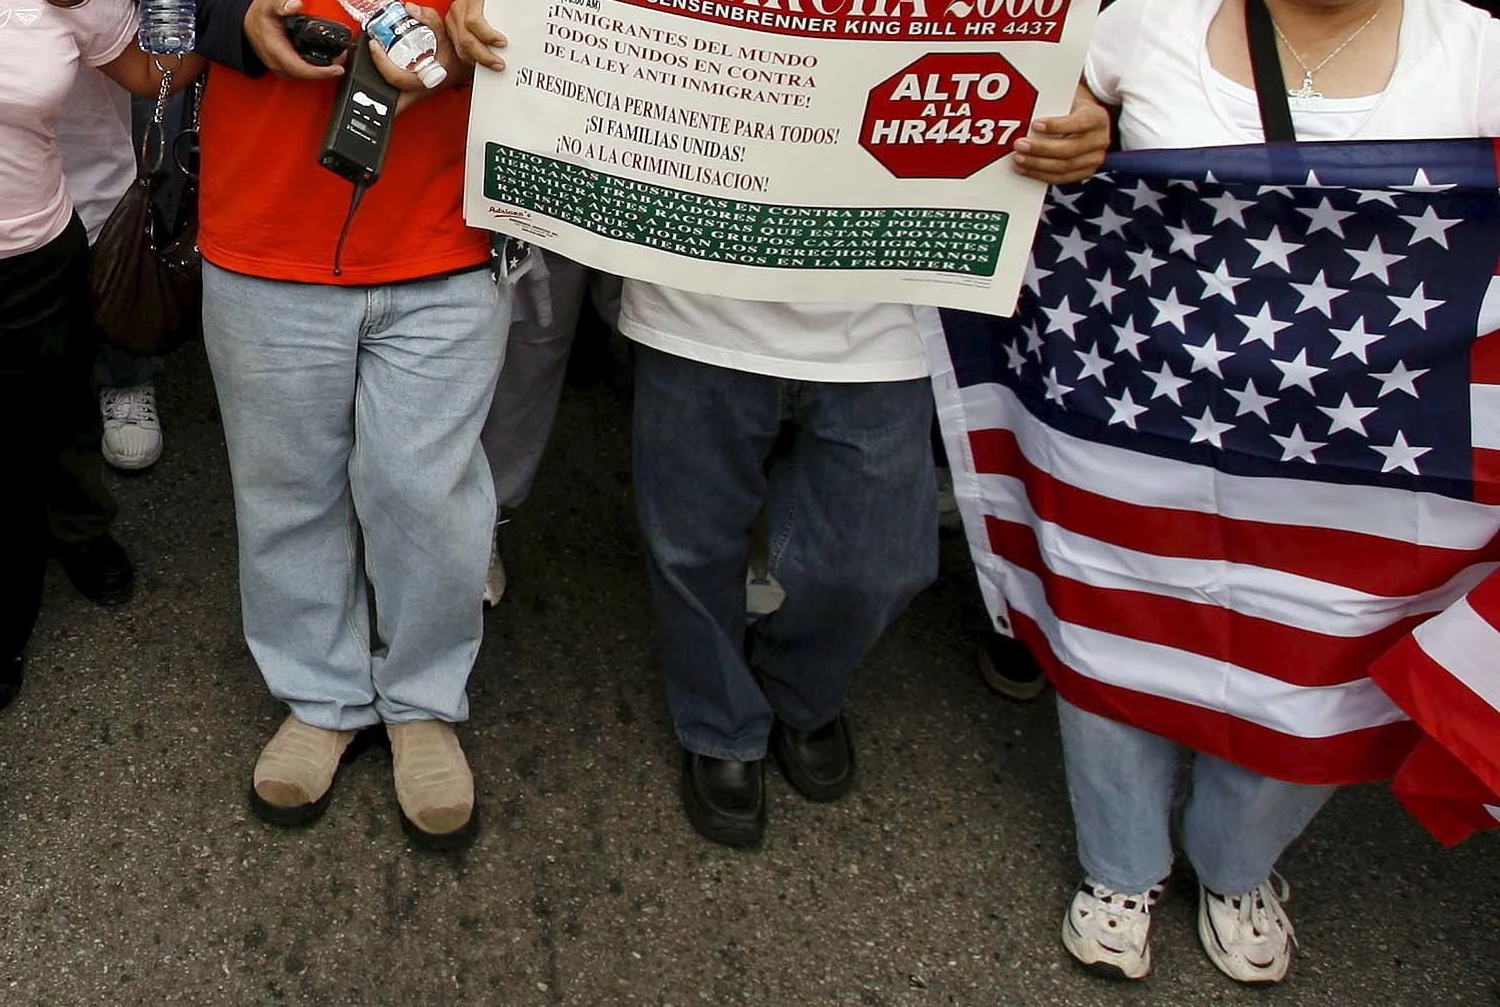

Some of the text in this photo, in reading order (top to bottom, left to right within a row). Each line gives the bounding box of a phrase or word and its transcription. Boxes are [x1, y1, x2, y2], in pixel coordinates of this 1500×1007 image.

[546, 22, 817, 88] TODOS UNIDOS EN CONTRA
[548, 5, 818, 68] ¡INMIGRANTES DEL MUNDO
[844, 20, 901, 35] KING
[908, 21, 957, 36] BILL
[964, 21, 995, 35] HR
[1002, 21, 1058, 35] 4437
[543, 41, 812, 109] DE LA LEY ANTI INMIGRANTE!
[890, 73, 1011, 102] ALTO
[515, 67, 841, 145] ¡SI RESIDENCIA PERMANENTE PARA TODOS!
[870, 119, 1021, 146] HR4437
[921, 103, 972, 117] A LA
[555, 135, 770, 193] ¡NO A LA CRIMINILISACION!
[584, 115, 746, 163] ¡SI FAMILIAS UNIDAS!
[496, 147, 1002, 221] ALTO A LAS INJUSTICIAS EN CONTRA DE NUESTROS
